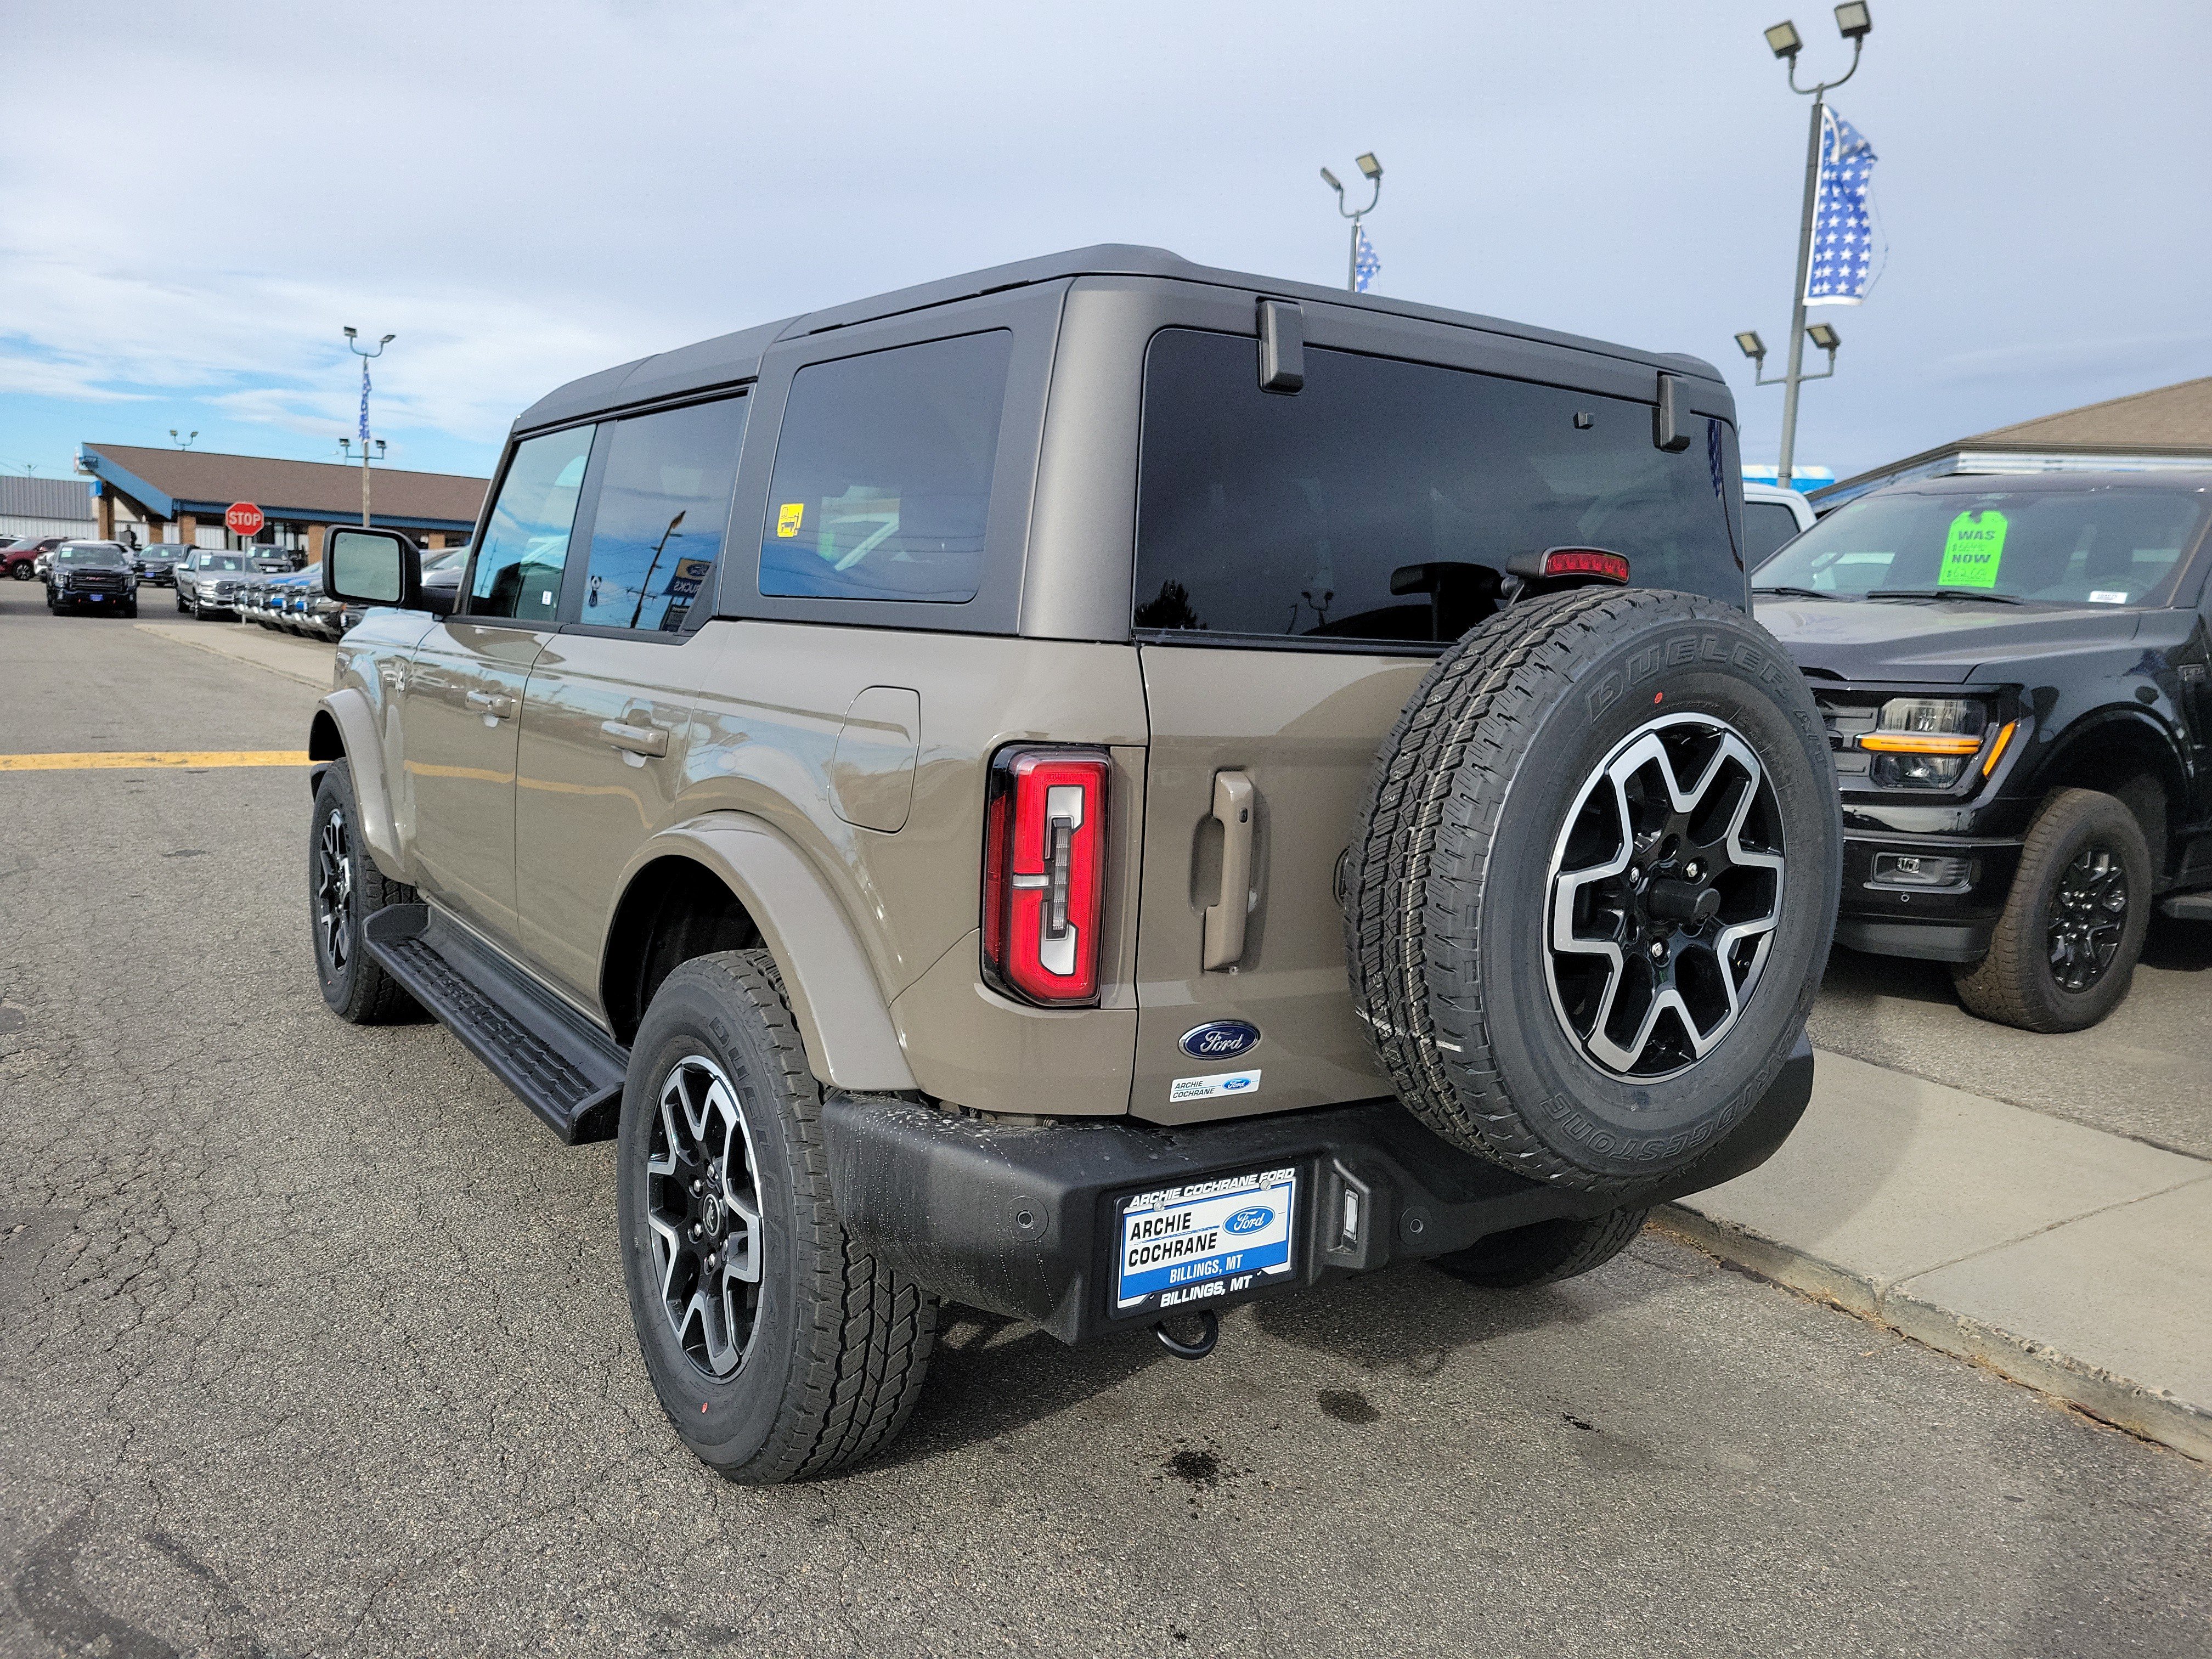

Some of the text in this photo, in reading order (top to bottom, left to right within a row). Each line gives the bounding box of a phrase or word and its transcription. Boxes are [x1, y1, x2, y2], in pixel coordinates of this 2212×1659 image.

[229, 511, 261, 526] STOP
[1958, 530, 1995, 540] WAS
[1952, 554, 1991, 564] NOW
[1585, 634, 1789, 723] DUELER
[1200, 1030, 1244, 1053] Ford
[1173, 1088, 1215, 1099] COCHRANE
[1175, 1079, 1245, 1090] ARCHIE Ford
[1129, 1167, 1295, 1207] ARCHIE COCHRANE FORD
[1130, 1211, 1264, 1241] ARCHIE Ford
[1128, 1232, 1217, 1267] COCHRANE
[1170, 1254, 1244, 1283] BILLINGS, MT
[1160, 1274, 1253, 1308] BILLINGS, MT
